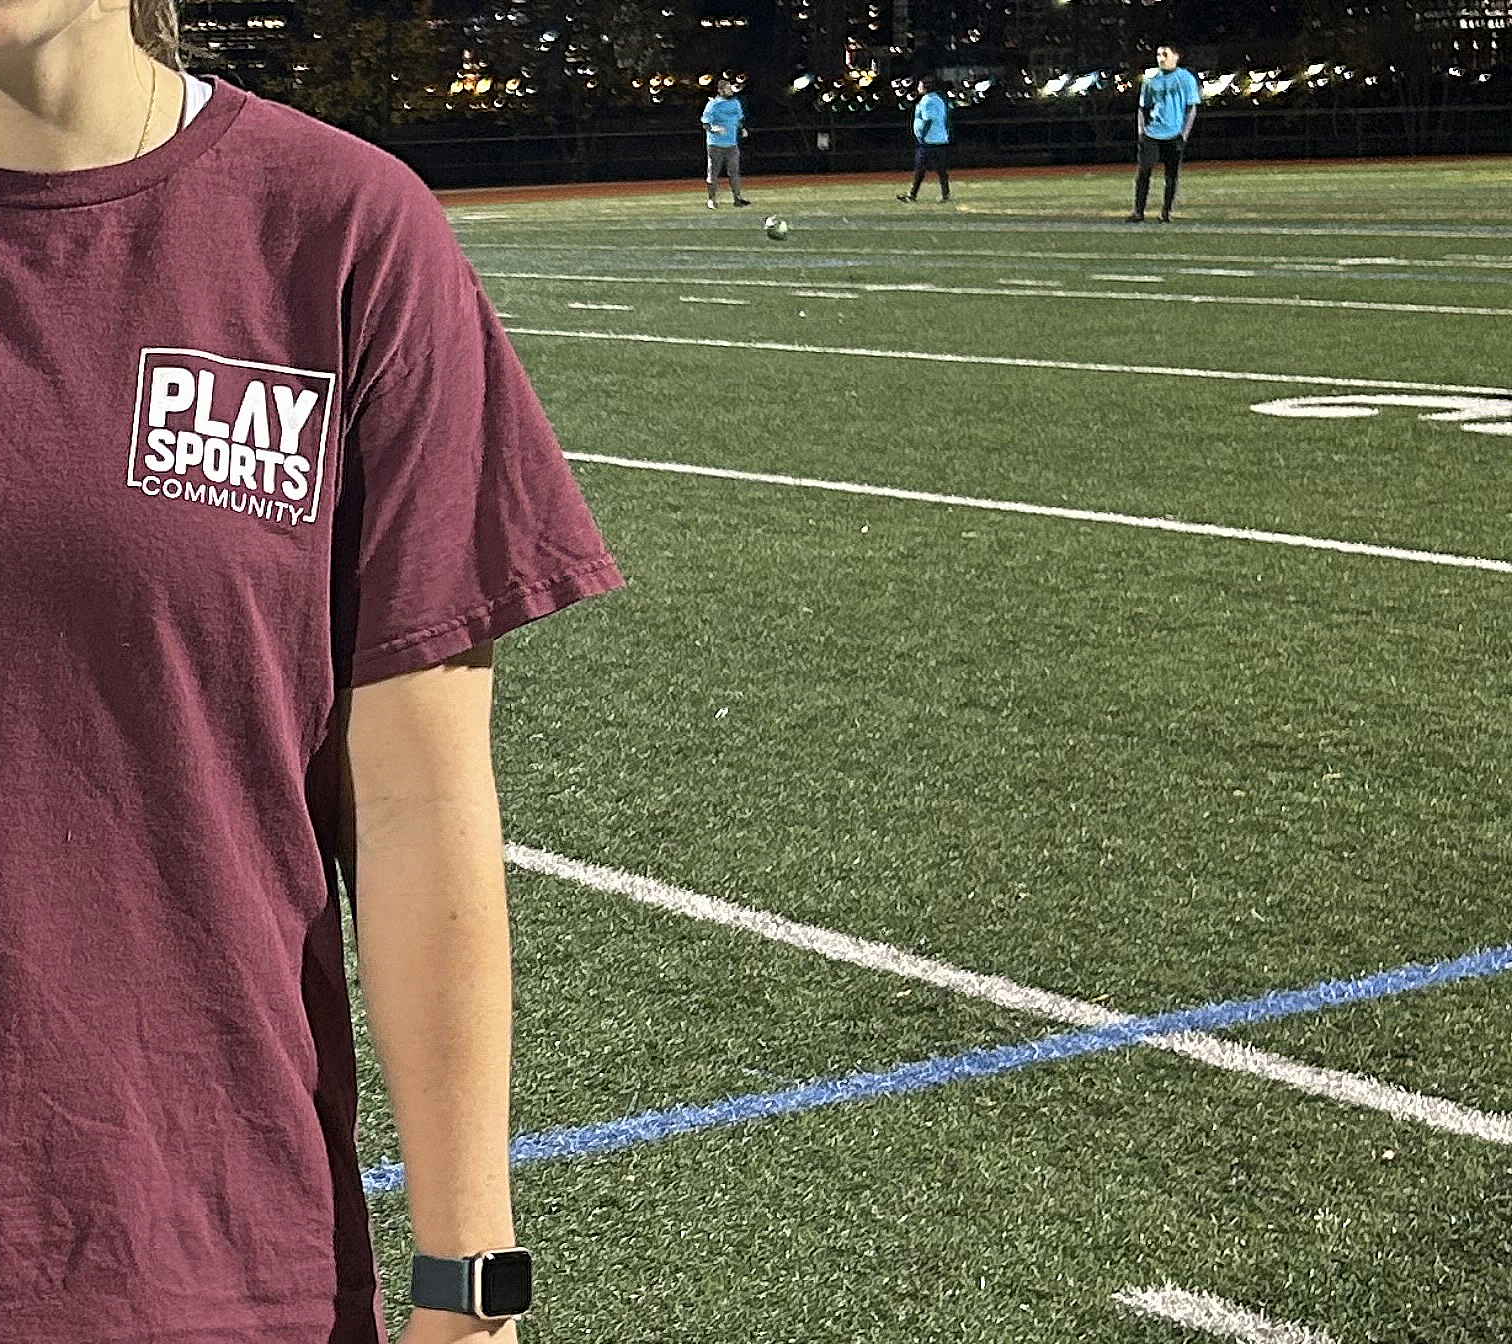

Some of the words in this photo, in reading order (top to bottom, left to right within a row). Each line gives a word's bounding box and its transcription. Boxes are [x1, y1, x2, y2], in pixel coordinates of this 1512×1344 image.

[148, 366, 319, 455] PLAY
[141, 475, 305, 526] COMMUNITY
[144, 428, 311, 501] SPORTS
